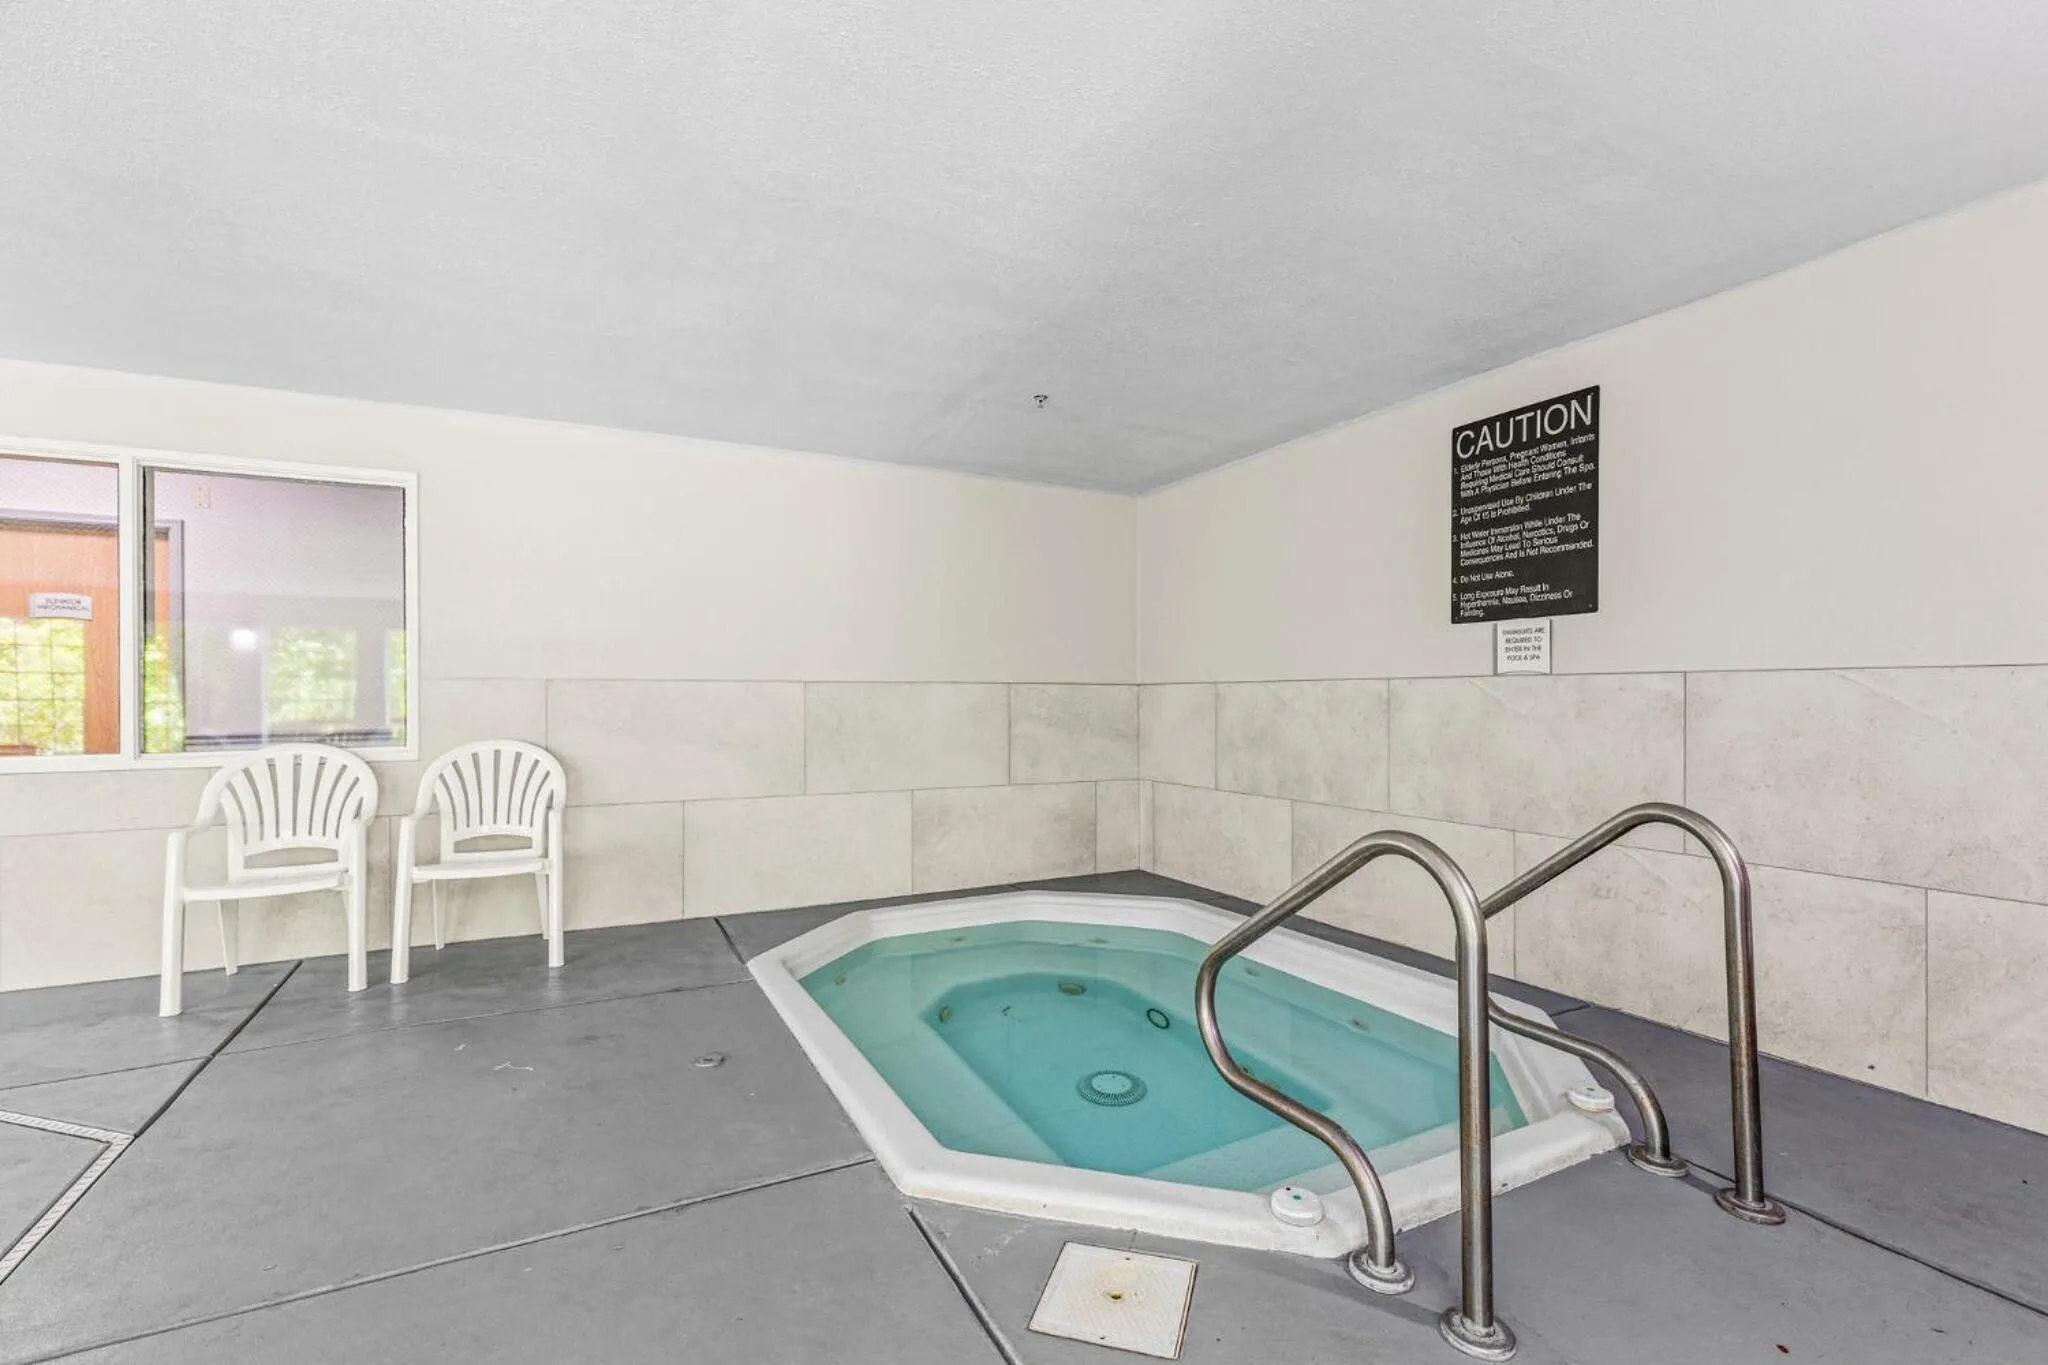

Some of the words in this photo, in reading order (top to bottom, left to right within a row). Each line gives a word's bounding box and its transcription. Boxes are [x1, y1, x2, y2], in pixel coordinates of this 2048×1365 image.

[1456, 395, 1592, 459] CAUTION
[1460, 472, 1472, 482] And
[1473, 469, 1491, 478] Those
[1493, 464, 1507, 473] With
[1508, 459, 1530, 470] Health
[1460, 478, 1489, 490] Requiring
[1489, 470, 1513, 483] Medical
[1514, 467, 1530, 477] Care
[1531, 460, 1556, 473] Should
[1556, 454, 1584, 468] Consult
[1474, 487, 1479, 496] A
[1480, 481, 1509, 494] Physician
[1510, 476, 1532, 488] Before
[1533, 470, 1562, 482] Entering
[1563, 465, 1577, 475] The
[1501, 497, 1514, 507] Use
[1514, 494, 1524, 506] By
[1525, 490, 1554, 502] Children
[1554, 485, 1577, 497] Under
[1577, 482, 1593, 492] The
[1460, 515, 1472, 525] Age
[1472, 512, 1481, 521] Of
[1460, 532, 1471, 541] Hot
[1471, 530, 1489, 539] Water
[1490, 523, 1523, 536] Immersion
[1523, 519, 1543, 530] While
[1543, 515, 1566, 527] Under
[1567, 512, 1581, 522] The
[1460, 539, 1487, 549] Influence
[1487, 535, 1496, 546] Of
[1521, 527, 1556, 539] Narcotics,
[1557, 523, 1579, 534] Drugs
[1579, 519, 1590, 530] Or
[1460, 546, 1489, 558] Medicines
[1490, 544, 1504, 554] May
[1504, 540, 1521, 551] Lead
[1522, 538, 1531, 548] To
[1532, 535, 1559, 547] Serious
[1460, 553, 1504, 567] Consequences
[1504, 549, 1518, 560] And
[1518, 549, 1526, 558] Is
[1526, 546, 1539, 557] Not
[1460, 575, 1469, 584] Do
[1469, 573, 1481, 582] Not
[1481, 572, 1494, 581] Use
[1460, 591, 1475, 602] Long
[1475, 588, 1504, 600] Exposure
[1505, 585, 1519, 596] May
[1520, 583, 1541, 594] Result
[1541, 582, 1550, 592] In
[1529, 591, 1562, 602] Dizziness
[1562, 588, 1574, 599] Or
